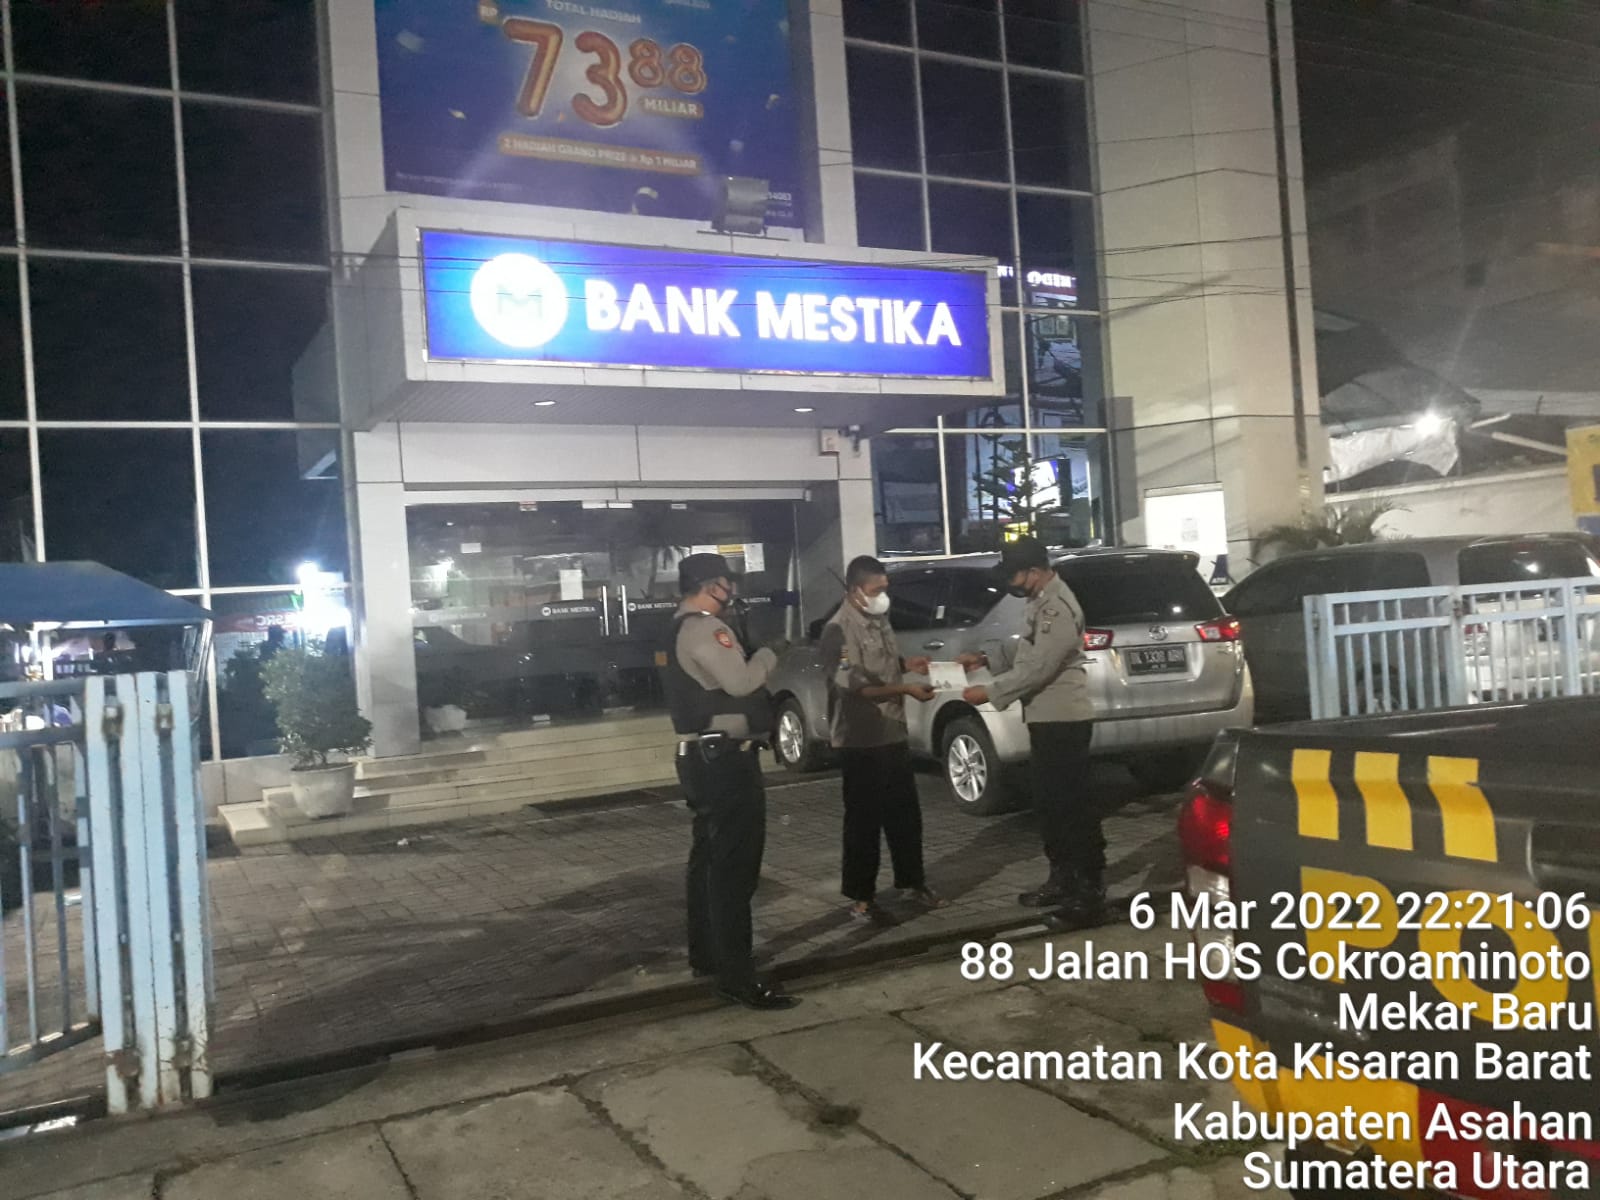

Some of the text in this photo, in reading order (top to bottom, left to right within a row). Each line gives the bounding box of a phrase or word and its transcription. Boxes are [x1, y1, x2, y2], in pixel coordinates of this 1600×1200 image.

[546, 0, 642, 24] TOTAL HADIAH
[643, 97, 699, 116] MILIAR
[513, 139, 557, 153] HADIAH
[558, 144, 596, 158] GRAND
[598, 149, 626, 162] PRIZE
[663, 157, 697, 169] MILIAR
[585, 278, 962, 347] BANK MESTIKA
[1300, 866, 1600, 1037] PO
